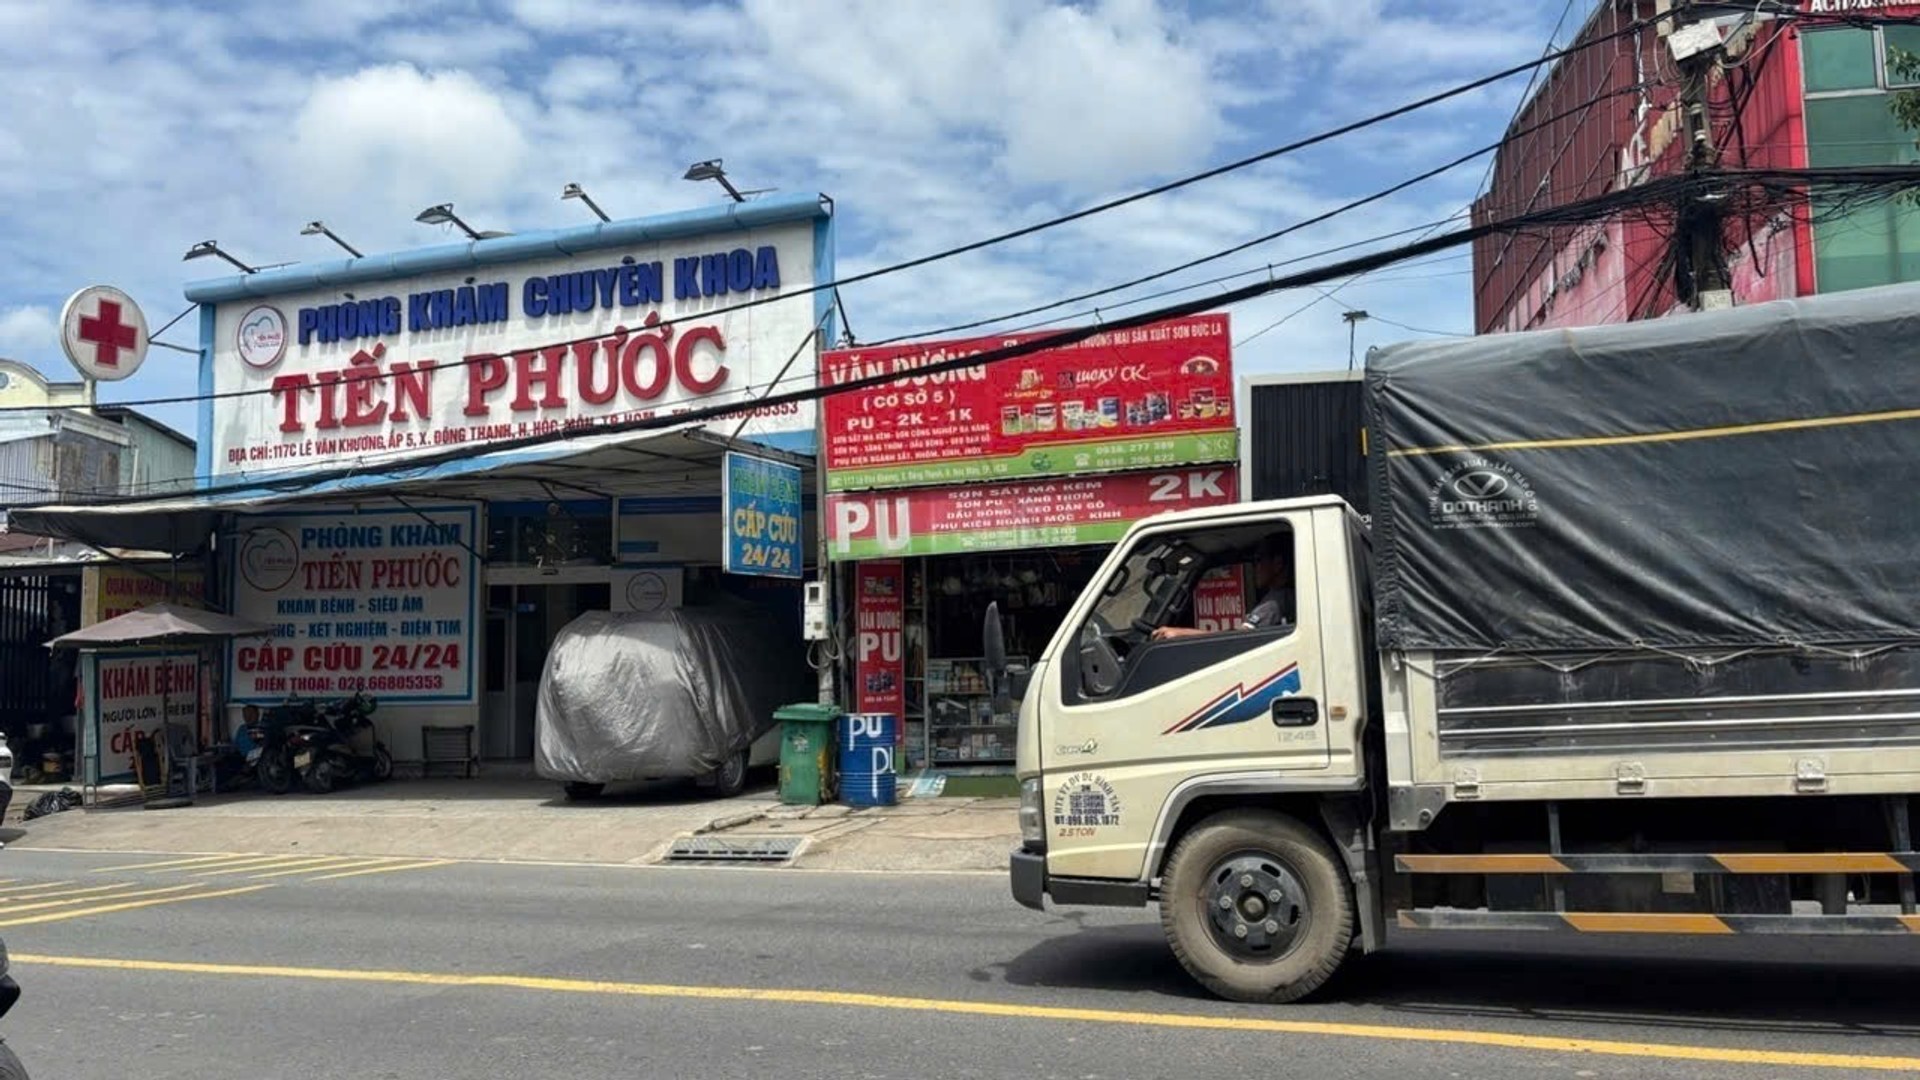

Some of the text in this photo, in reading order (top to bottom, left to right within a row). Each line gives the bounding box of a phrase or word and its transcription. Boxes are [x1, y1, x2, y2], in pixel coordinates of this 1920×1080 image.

[299, 246, 780, 346] PHÒNG KHÁM CHUYÊN KHOA
[1173, 325, 1189, 339] SƠN
[270, 311, 730, 433] TIẾN PHƯỚC
[829, 348, 987, 391] VĂN DƯƠNG
[873, 395, 900, 409] CƠ
[904, 388, 929, 406] SỞ
[933, 391, 944, 404] 5
[848, 417, 875, 430] PU
[897, 413, 924, 427] 2K
[229, 448, 247, 465] ĐỊA
[299, 439, 312, 457] LÊ
[315, 437, 337, 455] VĂN
[948, 489, 983, 499] SƠN
[1149, 470, 1225, 501] 2K
[955, 500, 981, 509] SƠN
[985, 498, 1003, 507] PU
[1442, 499, 1523, 514] DOTHANH
[302, 521, 383, 549] PHÒNG
[734, 499, 797, 545] CẤP CỨU
[835, 497, 910, 553] PU
[742, 543, 791, 569] 24/24
[302, 551, 362, 591] TIẾN
[371, 550, 460, 589] PHƯỚC
[277, 597, 316, 615] KHÁM
[320, 597, 355, 616] BỆNH
[367, 596, 398, 614] SIÊU
[336, 620, 387, 640] NGHIỆM
[401, 618, 431, 639] ĐIỆN
[436, 619, 461, 636] TIM
[237, 636, 460, 672] CẤP CỨU 24/24
[860, 632, 902, 662] PU
[102, 659, 195, 699] KHÁM BỆNH
[254, 675, 285, 693] ĐIỆN
[848, 716, 883, 752] PU
